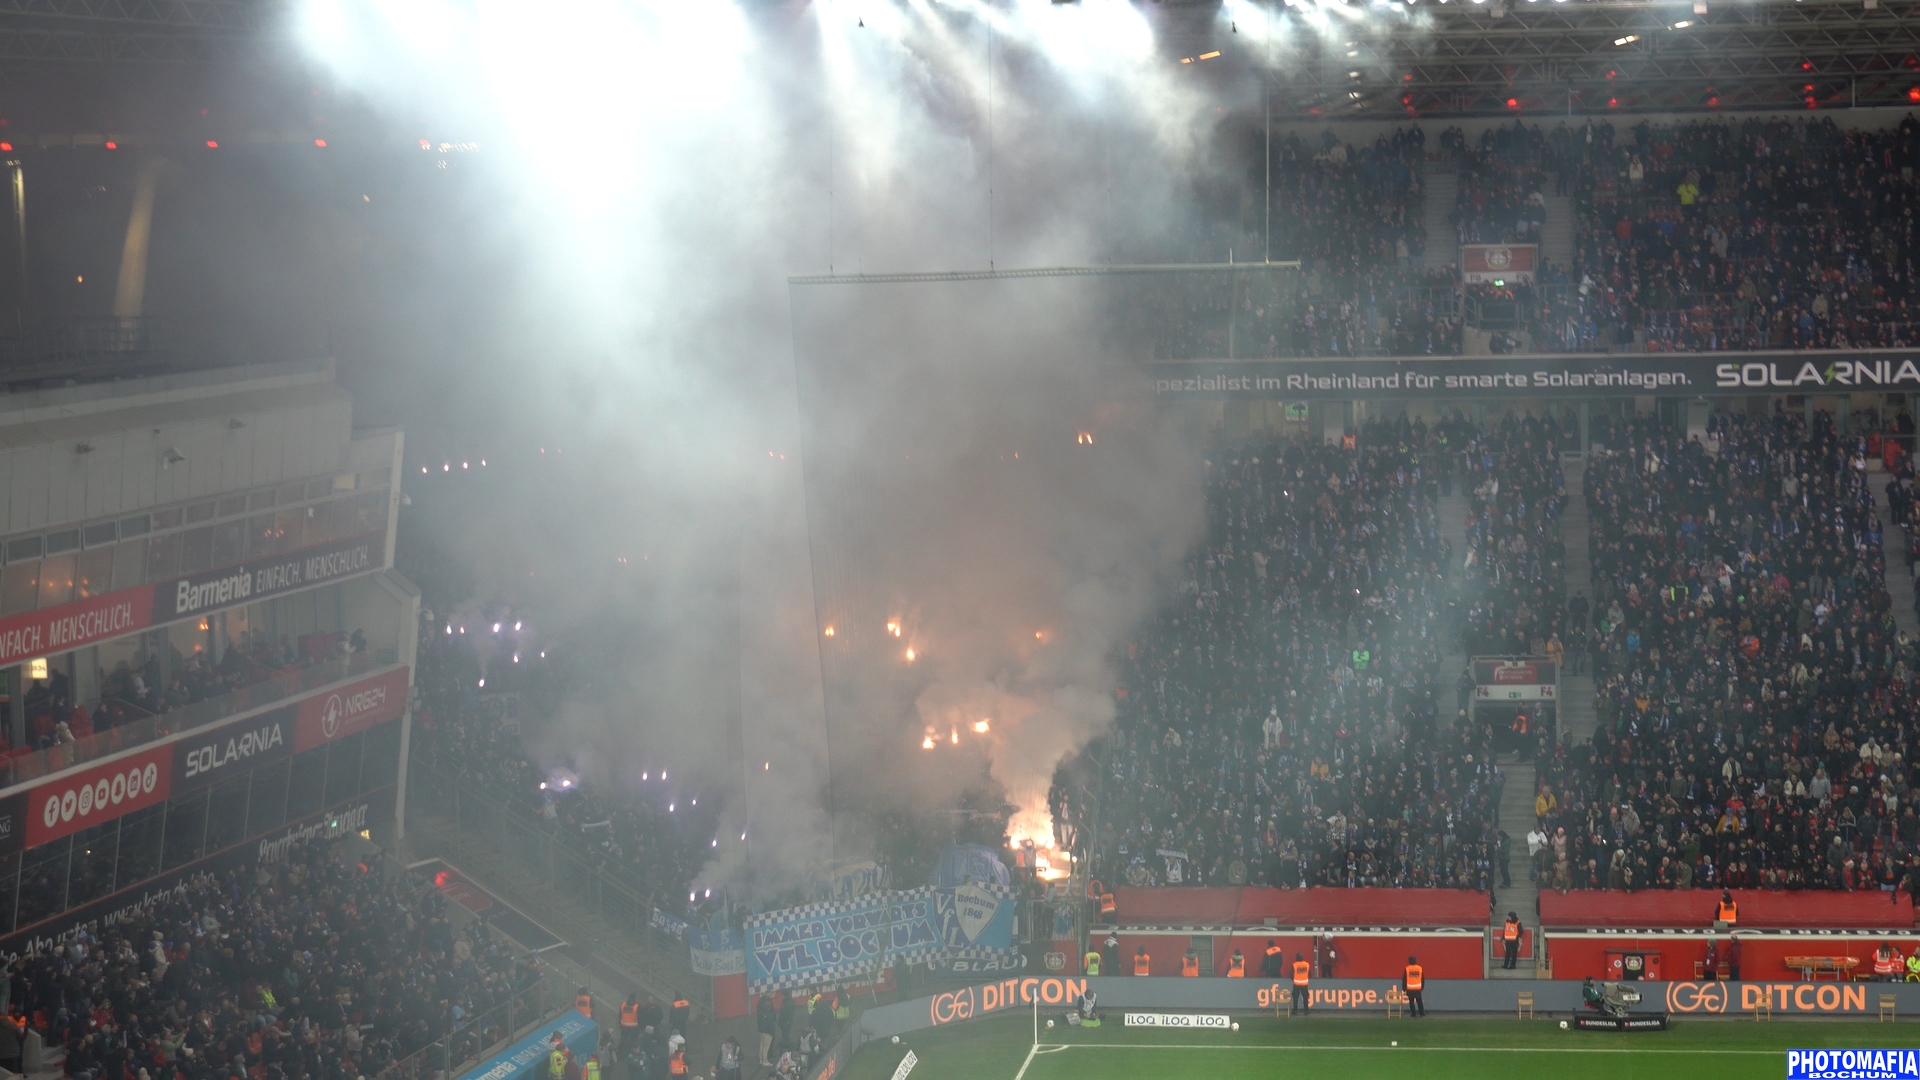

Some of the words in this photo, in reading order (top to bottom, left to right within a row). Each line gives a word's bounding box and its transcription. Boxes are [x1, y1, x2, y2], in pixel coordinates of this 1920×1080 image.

[1256, 374, 1281, 390] im
[1286, 372, 1399, 390] Rheinland
[1404, 371, 1440, 389] für
[1445, 371, 1528, 388] smarte
[1533, 369, 1692, 389] Solaranlagen.
[1716, 359, 1920, 387] SOLARNIA
[176, 566, 252, 614] Barmenia
[256, 562, 302, 593] EINFACH.
[305, 545, 370, 581] MENSCHLICH.
[50, 602, 135, 648] MENSCHLICH.
[345, 685, 386, 717] NRG24
[1477, 687, 1489, 697] F4
[1541, 687, 1553, 697] F4
[185, 722, 283, 778] SOLARNIA
[957, 893, 995, 910] Bochum
[963, 907, 983, 919] 1848
[754, 921, 826, 949] IMMER
[826, 901, 928, 935] VORWÄRTS
[817, 919, 937, 965] BOCHUM
[983, 978, 1087, 1011] DITCON
[1257, 984, 1410, 1008] gfcgruppe.de
[1741, 984, 1866, 1011] DITCON
[1127, 1015, 1156, 1025] iLOQ
[1162, 1016, 1191, 1026] iLOQ
[1196, 1016, 1226, 1026] iLOQ
